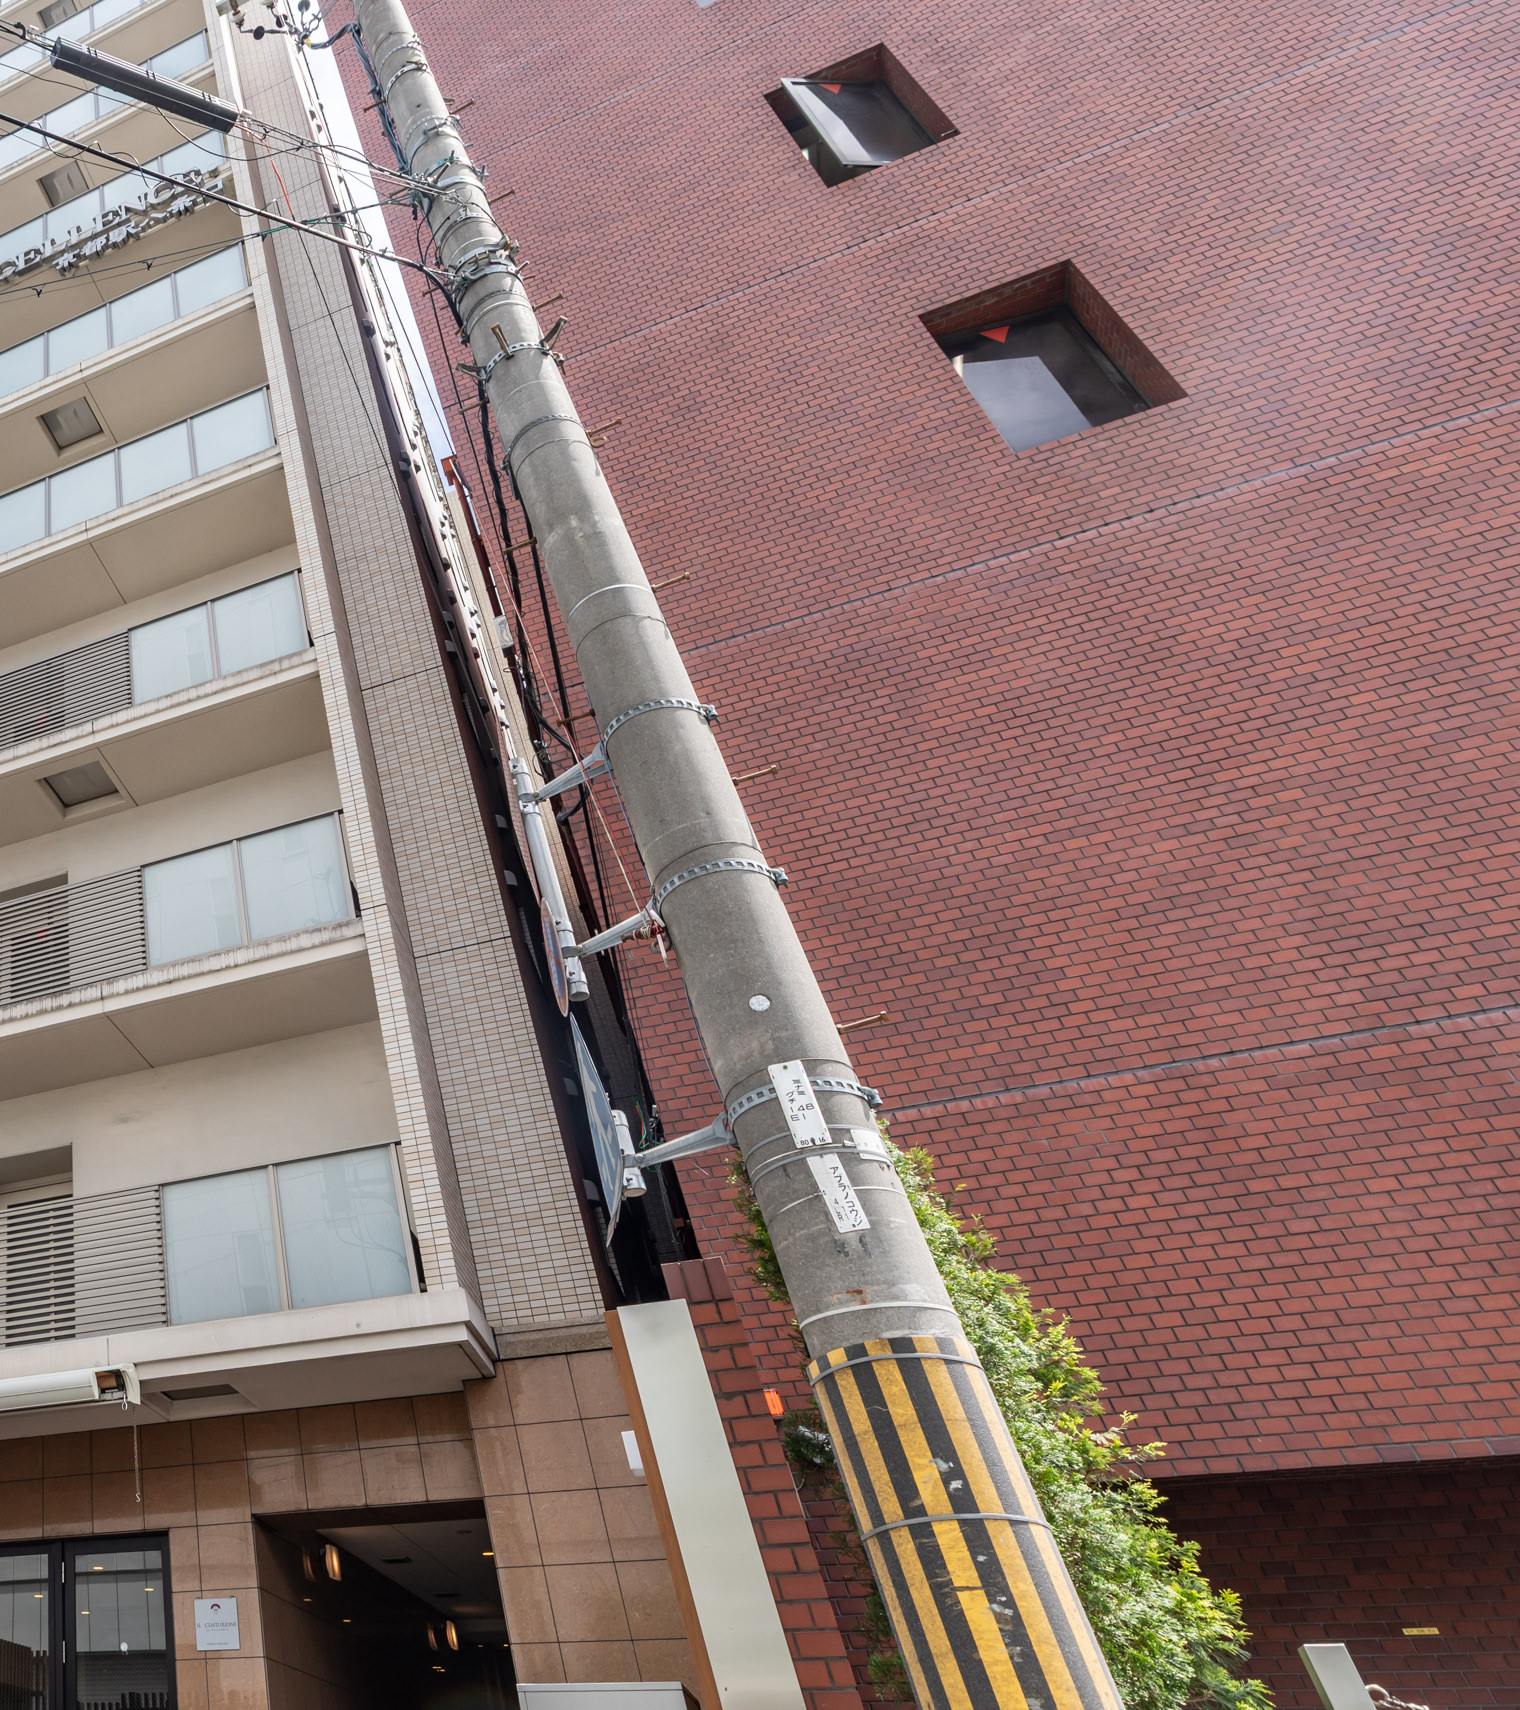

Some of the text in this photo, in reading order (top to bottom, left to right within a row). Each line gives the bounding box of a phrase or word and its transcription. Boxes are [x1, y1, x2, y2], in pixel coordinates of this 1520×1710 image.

[52, 179, 224, 277] 京都駅八条口
